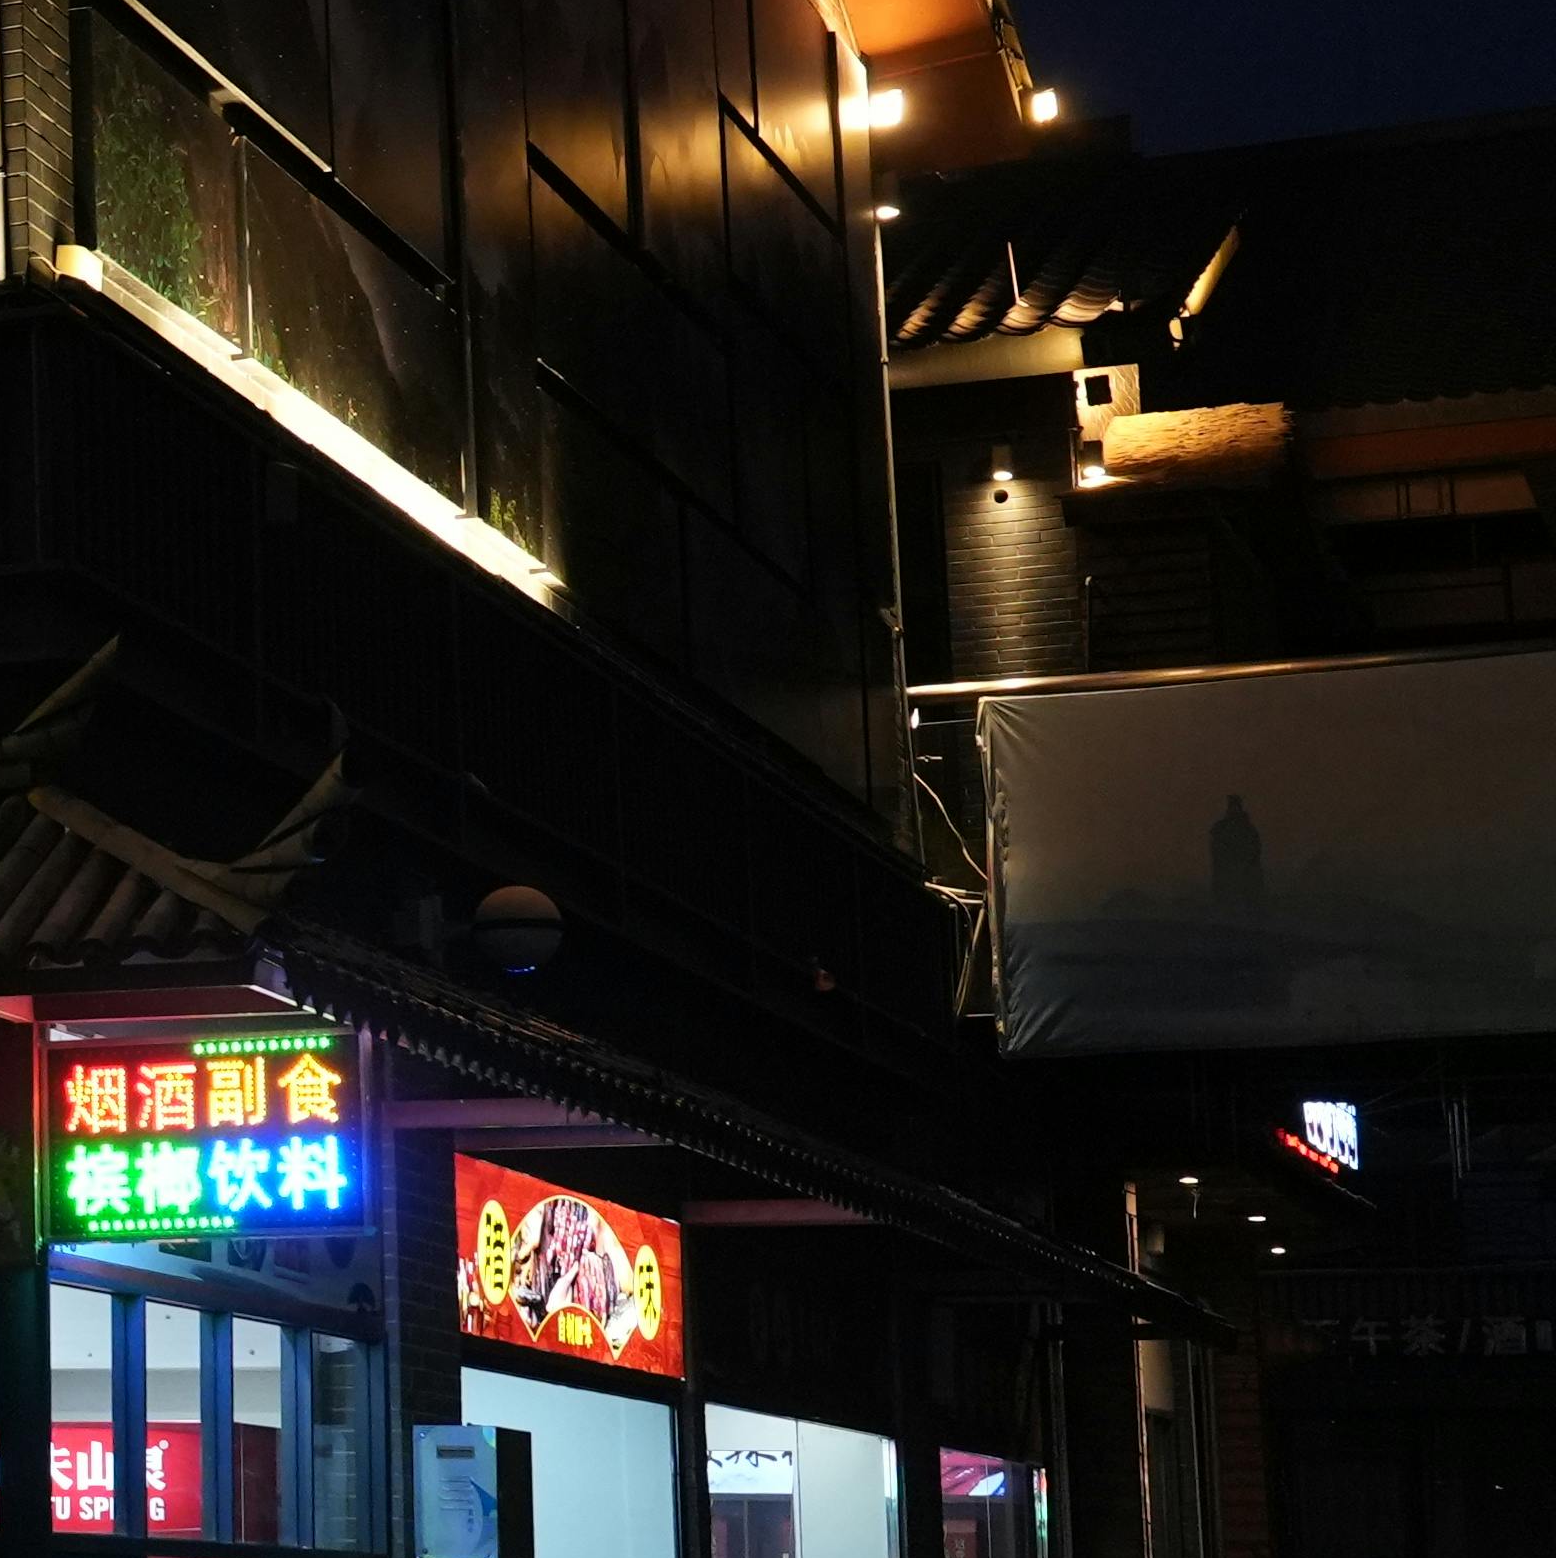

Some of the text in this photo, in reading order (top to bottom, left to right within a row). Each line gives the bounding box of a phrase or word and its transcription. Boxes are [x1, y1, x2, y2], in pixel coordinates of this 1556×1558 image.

[64, 1053, 342, 1133] 烟酒副食
[65, 1134, 347, 1215] 槟榔饮料
[638, 1259, 657, 1327] 味
[79, 1495, 166, 1523] SPG
